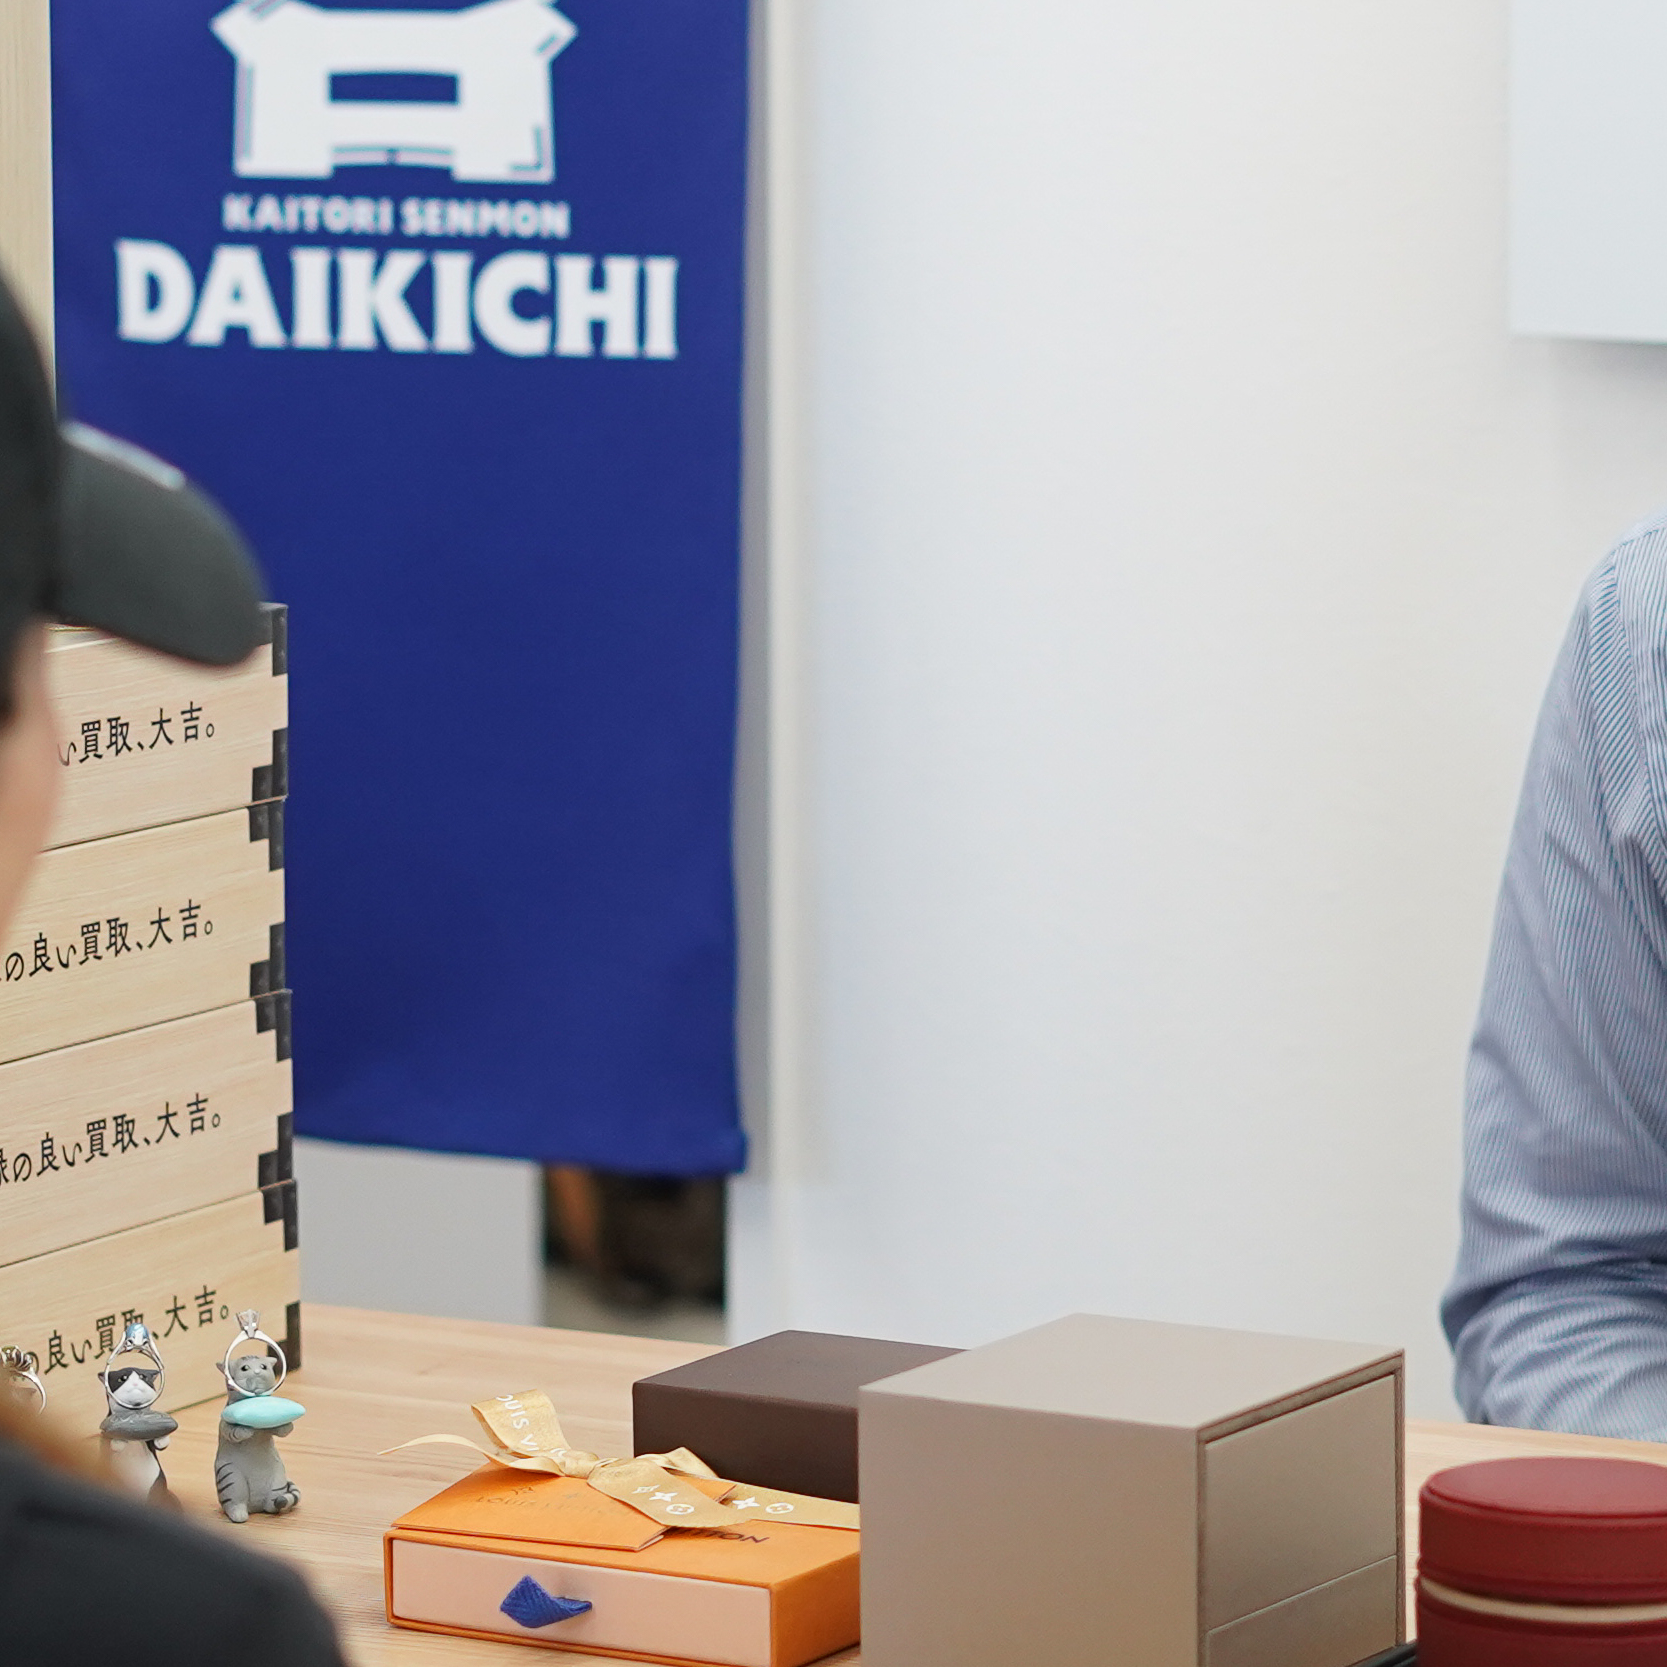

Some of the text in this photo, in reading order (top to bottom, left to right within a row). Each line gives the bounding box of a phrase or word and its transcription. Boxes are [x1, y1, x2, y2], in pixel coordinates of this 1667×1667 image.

[223, 193, 571, 238] KAITORI SENMON
[116, 239, 677, 360] DAIKICHI
[57, 700, 215, 767] い買取、大吉。
